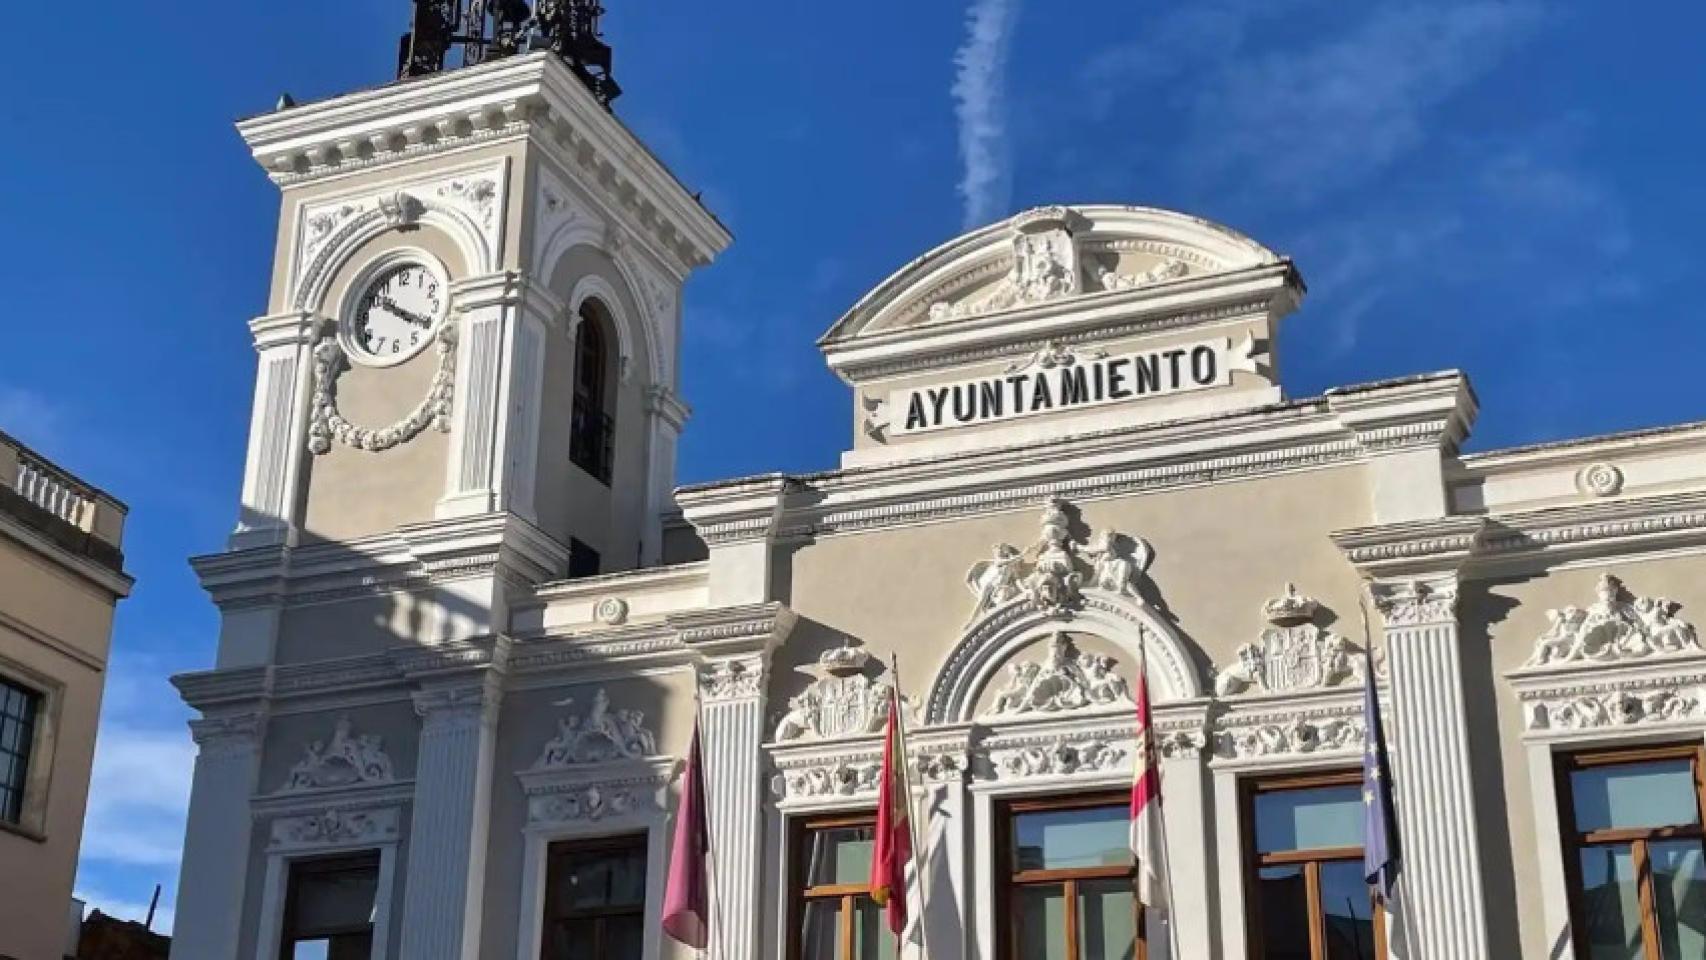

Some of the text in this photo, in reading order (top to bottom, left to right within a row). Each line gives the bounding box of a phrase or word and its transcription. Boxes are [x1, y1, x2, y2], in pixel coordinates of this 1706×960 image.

[428, 283, 436, 299] 2
[376, 336, 386, 353] 7
[393, 338, 400, 353] 6
[411, 331, 419, 346] 5
[905, 345, 1217, 429] AYUNTAMIENTO
